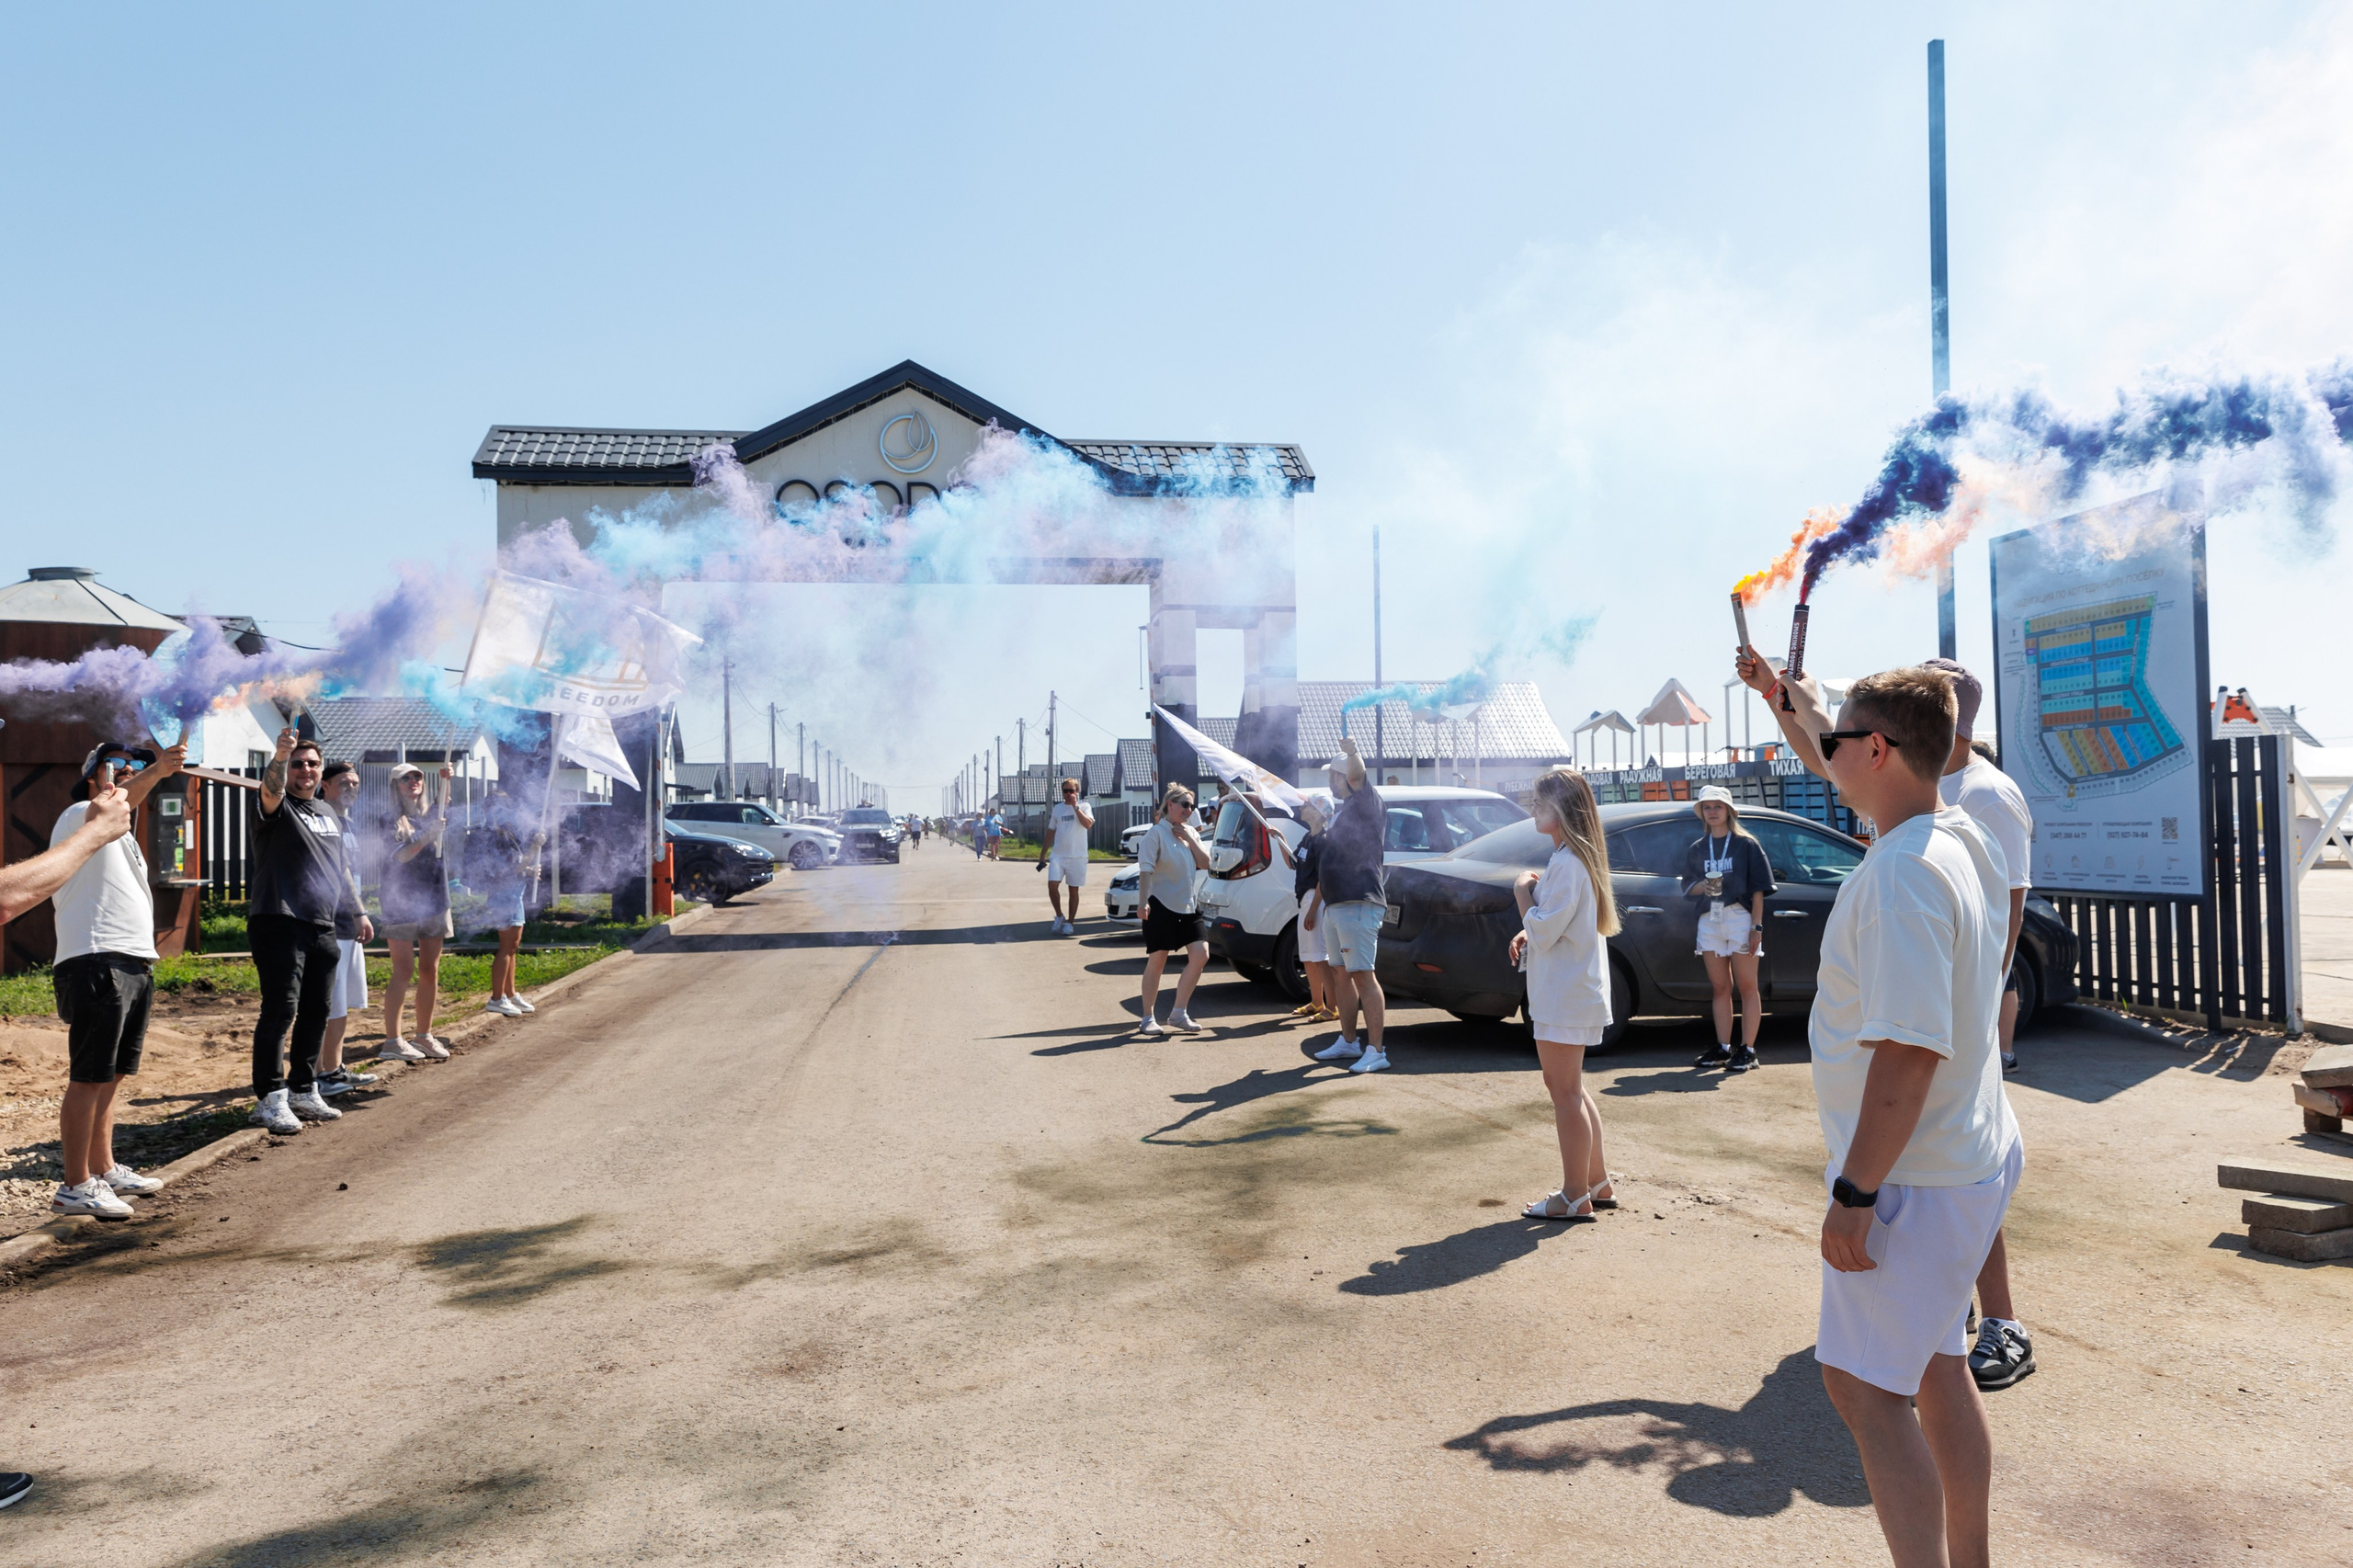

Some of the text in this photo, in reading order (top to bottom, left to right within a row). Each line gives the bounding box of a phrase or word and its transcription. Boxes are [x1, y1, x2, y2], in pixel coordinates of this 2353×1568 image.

[1790, 622, 1800, 651] SMOKING
[540, 682, 640, 707] REEDOM
[1620, 768, 1663, 784] РАДУЖНАЯ
[1685, 763, 1736, 780] БЕРЕГОВАЯ
[1768, 759, 1804, 776] ТИХАЯ
